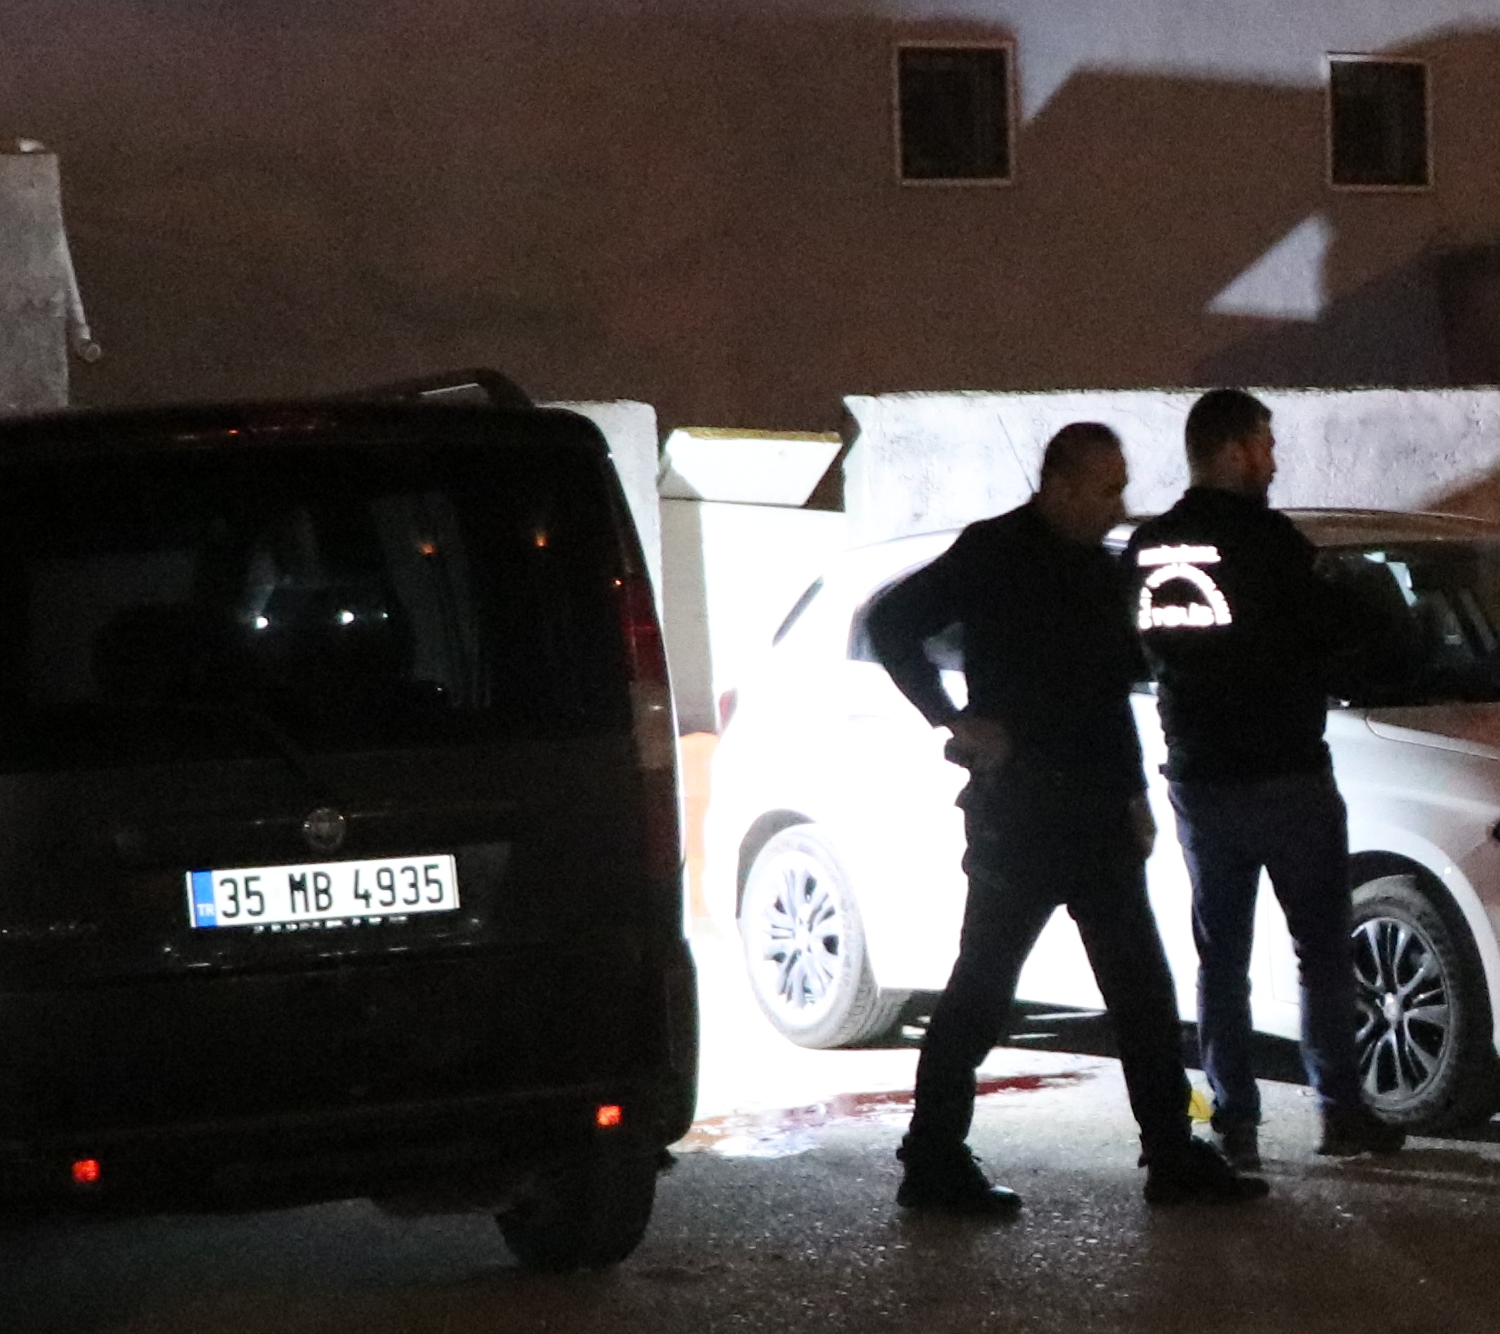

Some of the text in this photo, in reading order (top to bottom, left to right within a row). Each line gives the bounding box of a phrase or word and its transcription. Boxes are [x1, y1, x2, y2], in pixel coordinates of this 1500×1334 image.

[219, 864, 444, 918] 35 MB 4935
